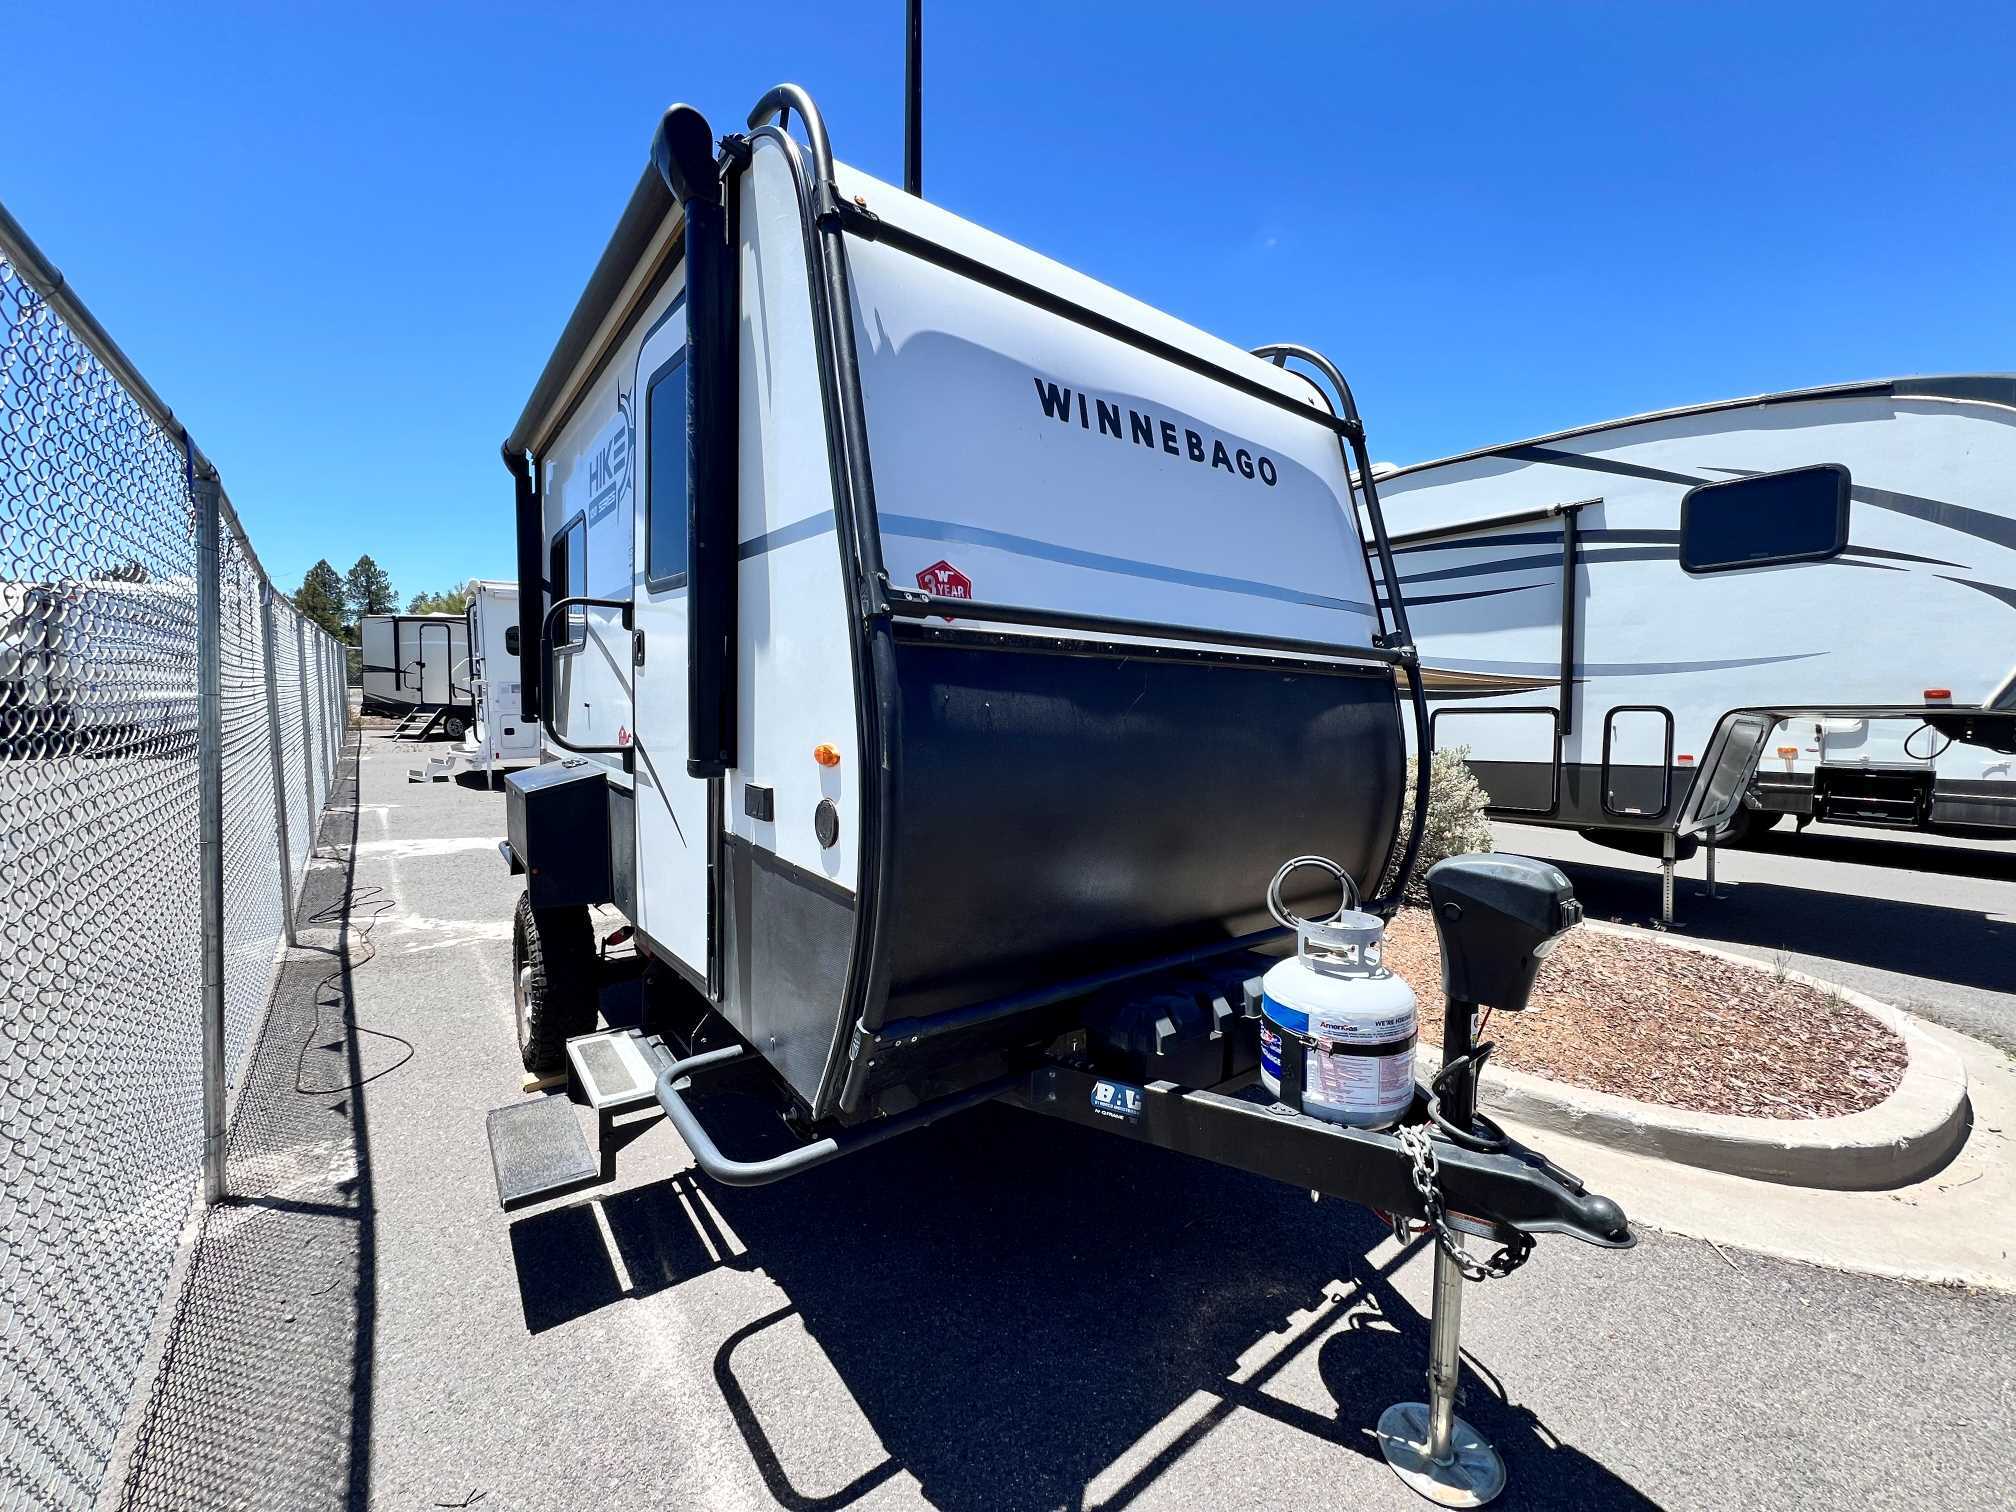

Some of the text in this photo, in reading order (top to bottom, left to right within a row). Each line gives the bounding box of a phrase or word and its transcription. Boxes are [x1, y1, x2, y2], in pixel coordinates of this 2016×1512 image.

[589, 424, 626, 498] HIKE
[1034, 377, 1278, 487] WINNEBAGO
[937, 583, 965, 598] YEAR
